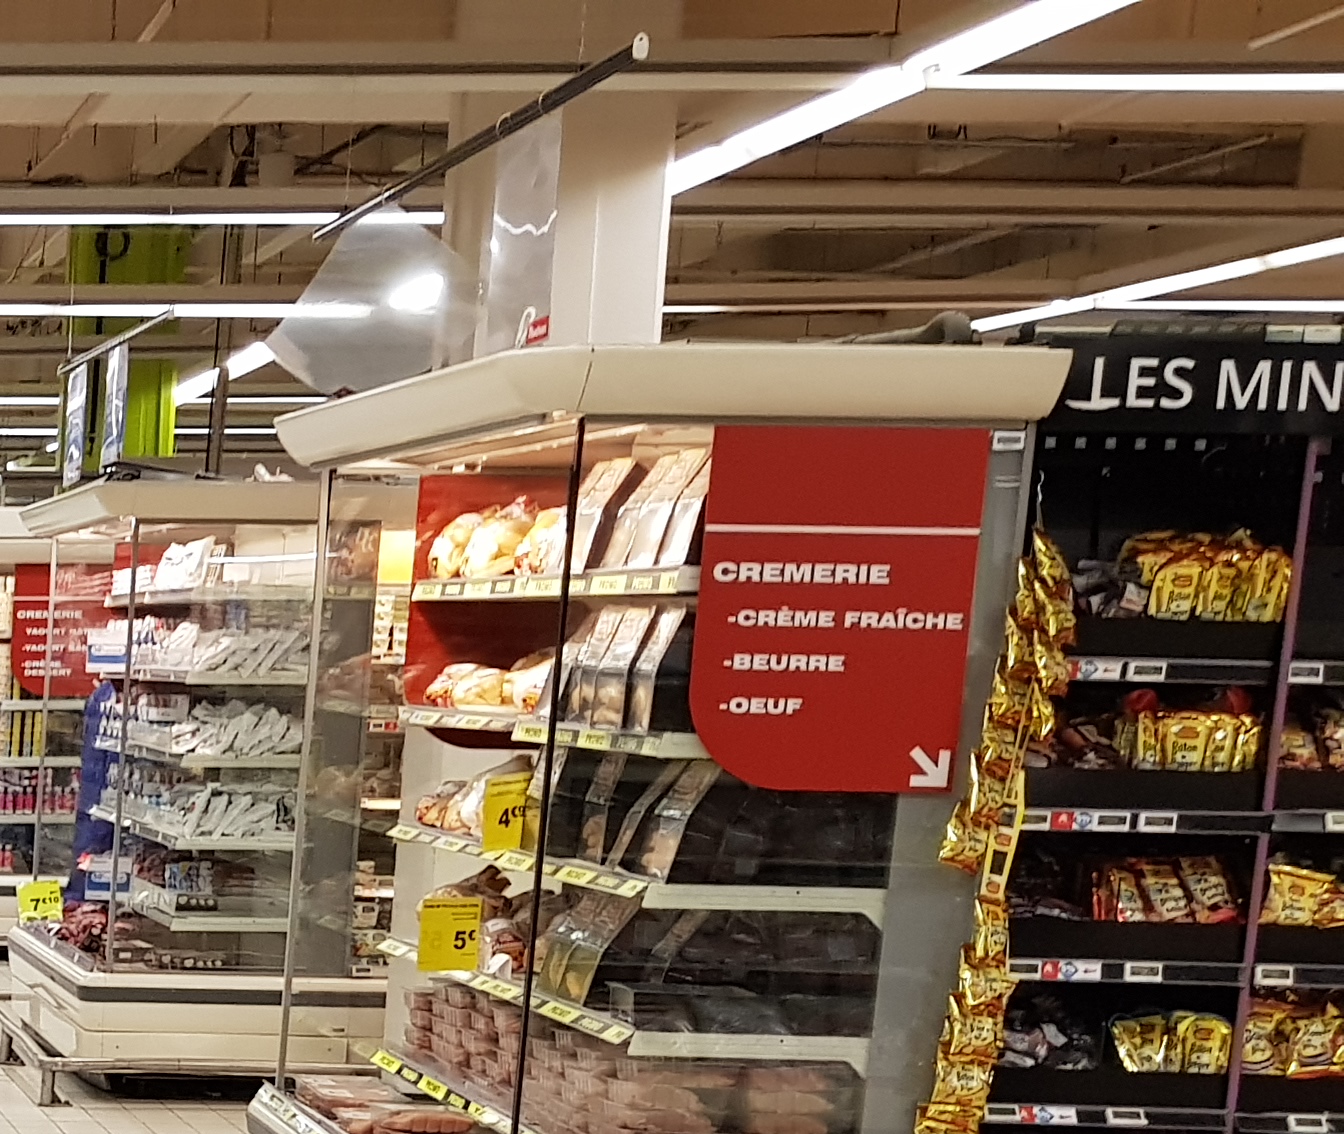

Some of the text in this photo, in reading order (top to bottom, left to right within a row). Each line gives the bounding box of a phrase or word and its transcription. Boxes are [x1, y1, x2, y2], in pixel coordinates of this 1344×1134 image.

[1065, 356, 1196, 411] LES
[712, 562, 890, 586] CREMERIE
[727, 605, 964, 631] -CRÈME FRAÎCHE
[24, 668, 72, 677] DESERT
[722, 652, 845, 673] -BEURRE
[719, 696, 804, 714] -OEUF
